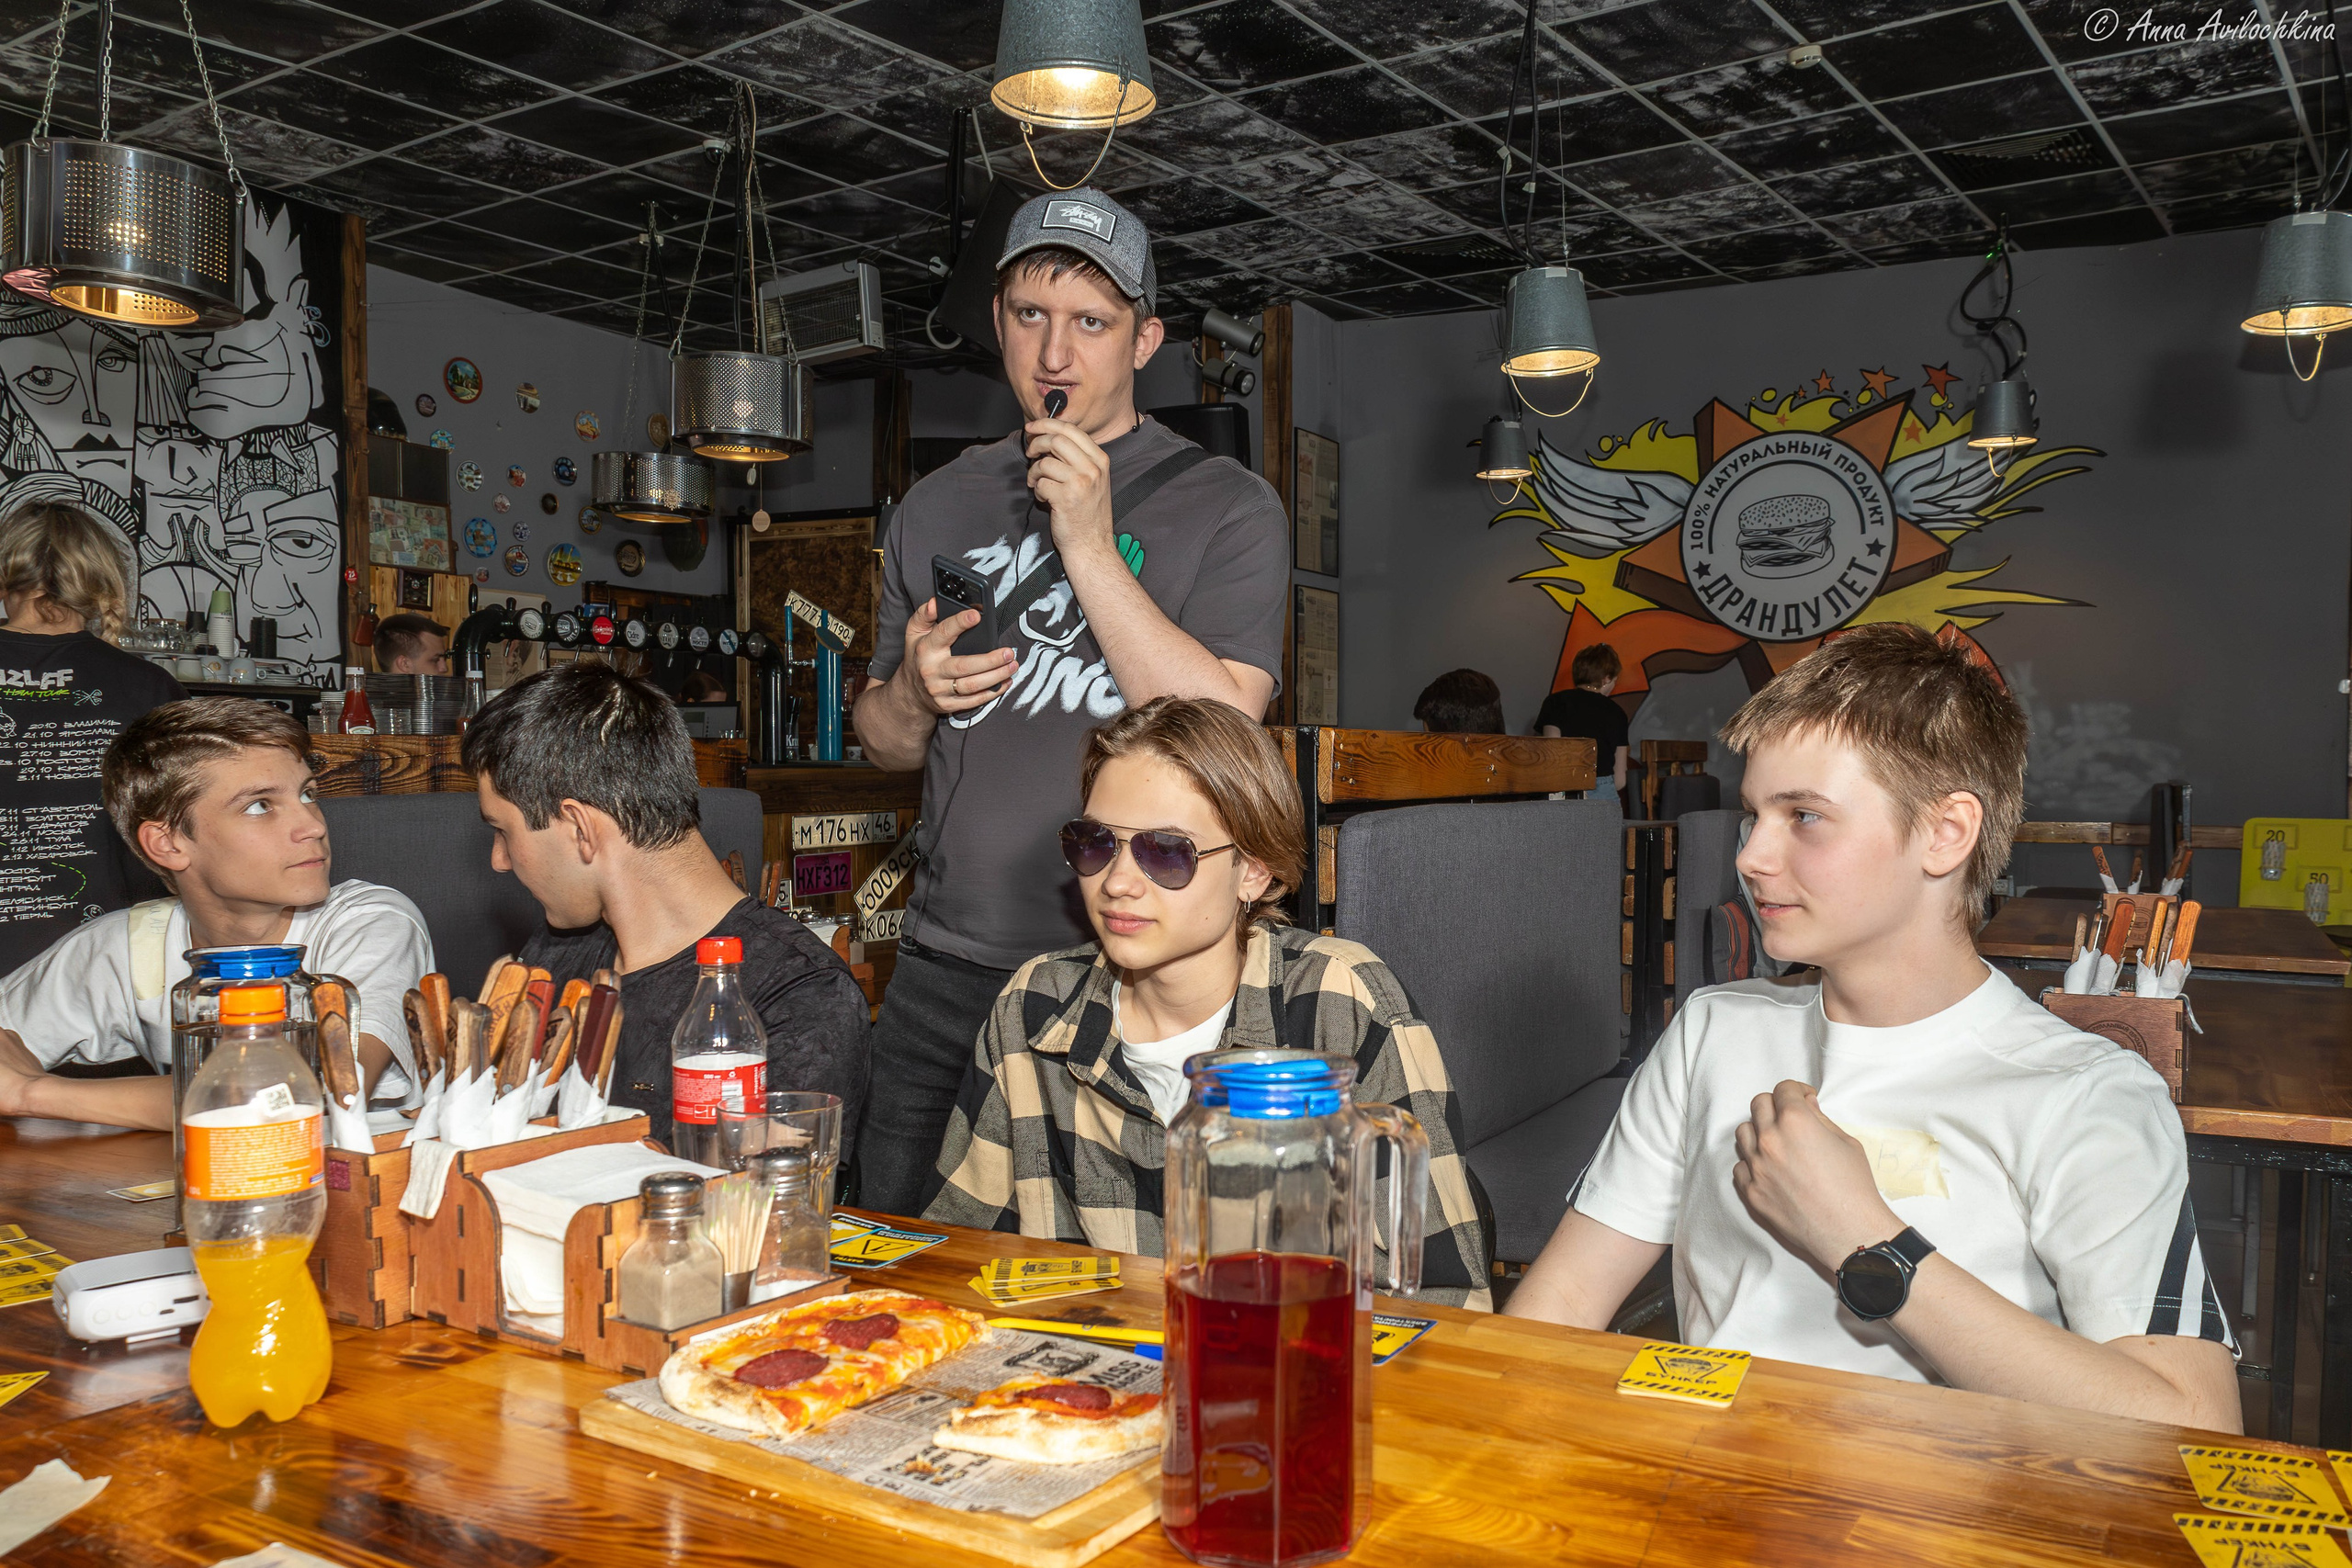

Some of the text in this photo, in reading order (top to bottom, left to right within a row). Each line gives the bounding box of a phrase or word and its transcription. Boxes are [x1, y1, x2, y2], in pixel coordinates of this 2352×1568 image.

[1690, 440, 1884, 550] 100% НАТУРАЛЬНЫЙ ПРОДУКТ
[1698, 557, 1878, 637] ДРАНДУЛЕТ
[59, 748, 107, 757] ВОРОНЕ
[21, 804, 104, 814] СТАВРОПОЛЬ
[25, 813, 96, 822] ВОЛГОГРАД
[28, 820, 89, 829] САРАТОВ
[37, 828, 83, 836] МОСКВА
[2266, 829, 2286, 842] 20
[2309, 873, 2329, 885] 50
[1645, 1371, 1717, 1384] БУНКЕР
